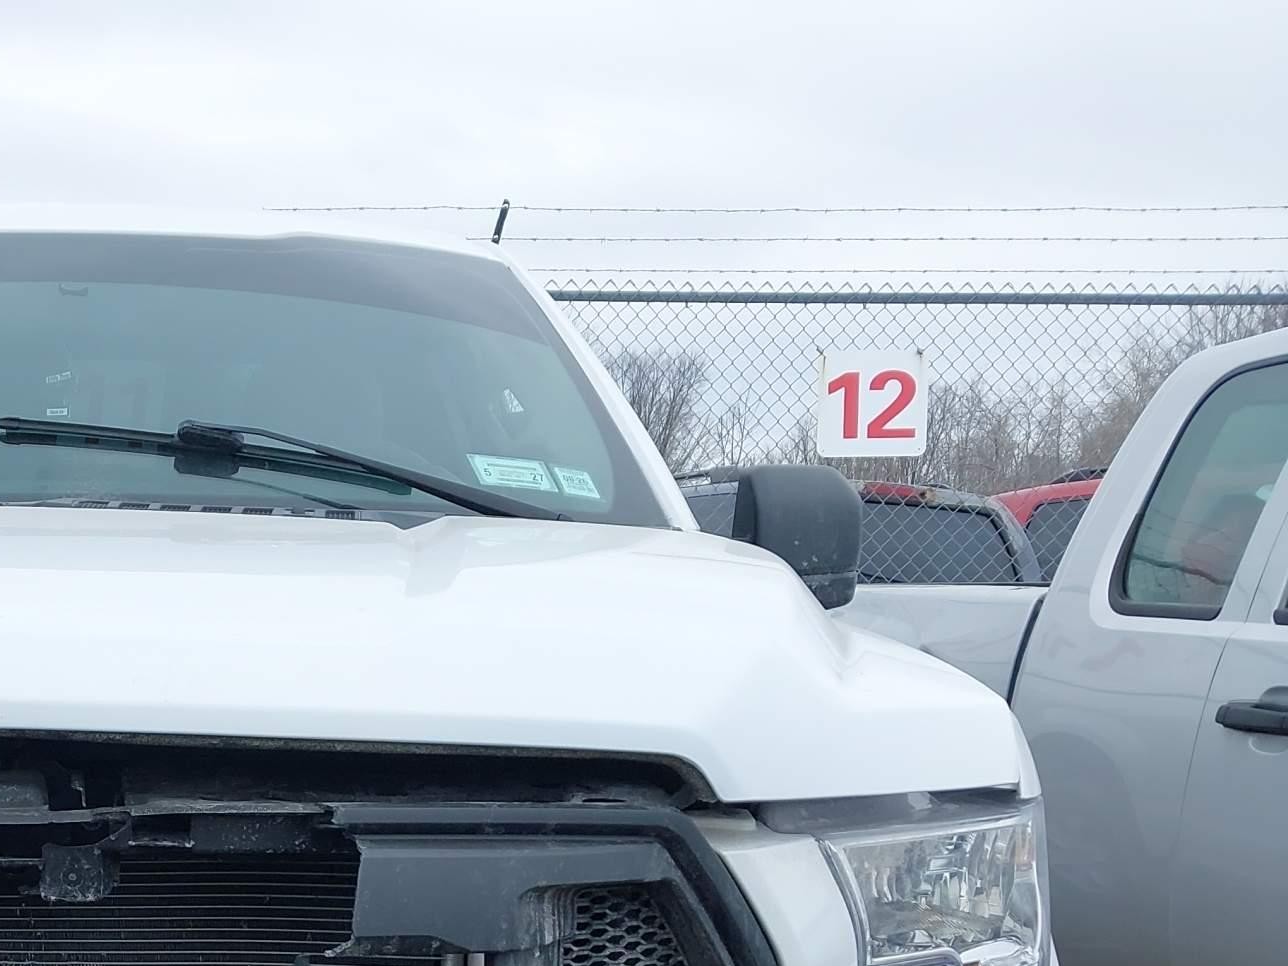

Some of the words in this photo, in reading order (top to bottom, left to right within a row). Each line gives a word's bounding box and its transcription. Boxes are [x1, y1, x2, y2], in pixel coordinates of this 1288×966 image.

[827, 370, 916, 440] 12
[483, 467, 492, 477] 5
[530, 471, 544, 482] 27
